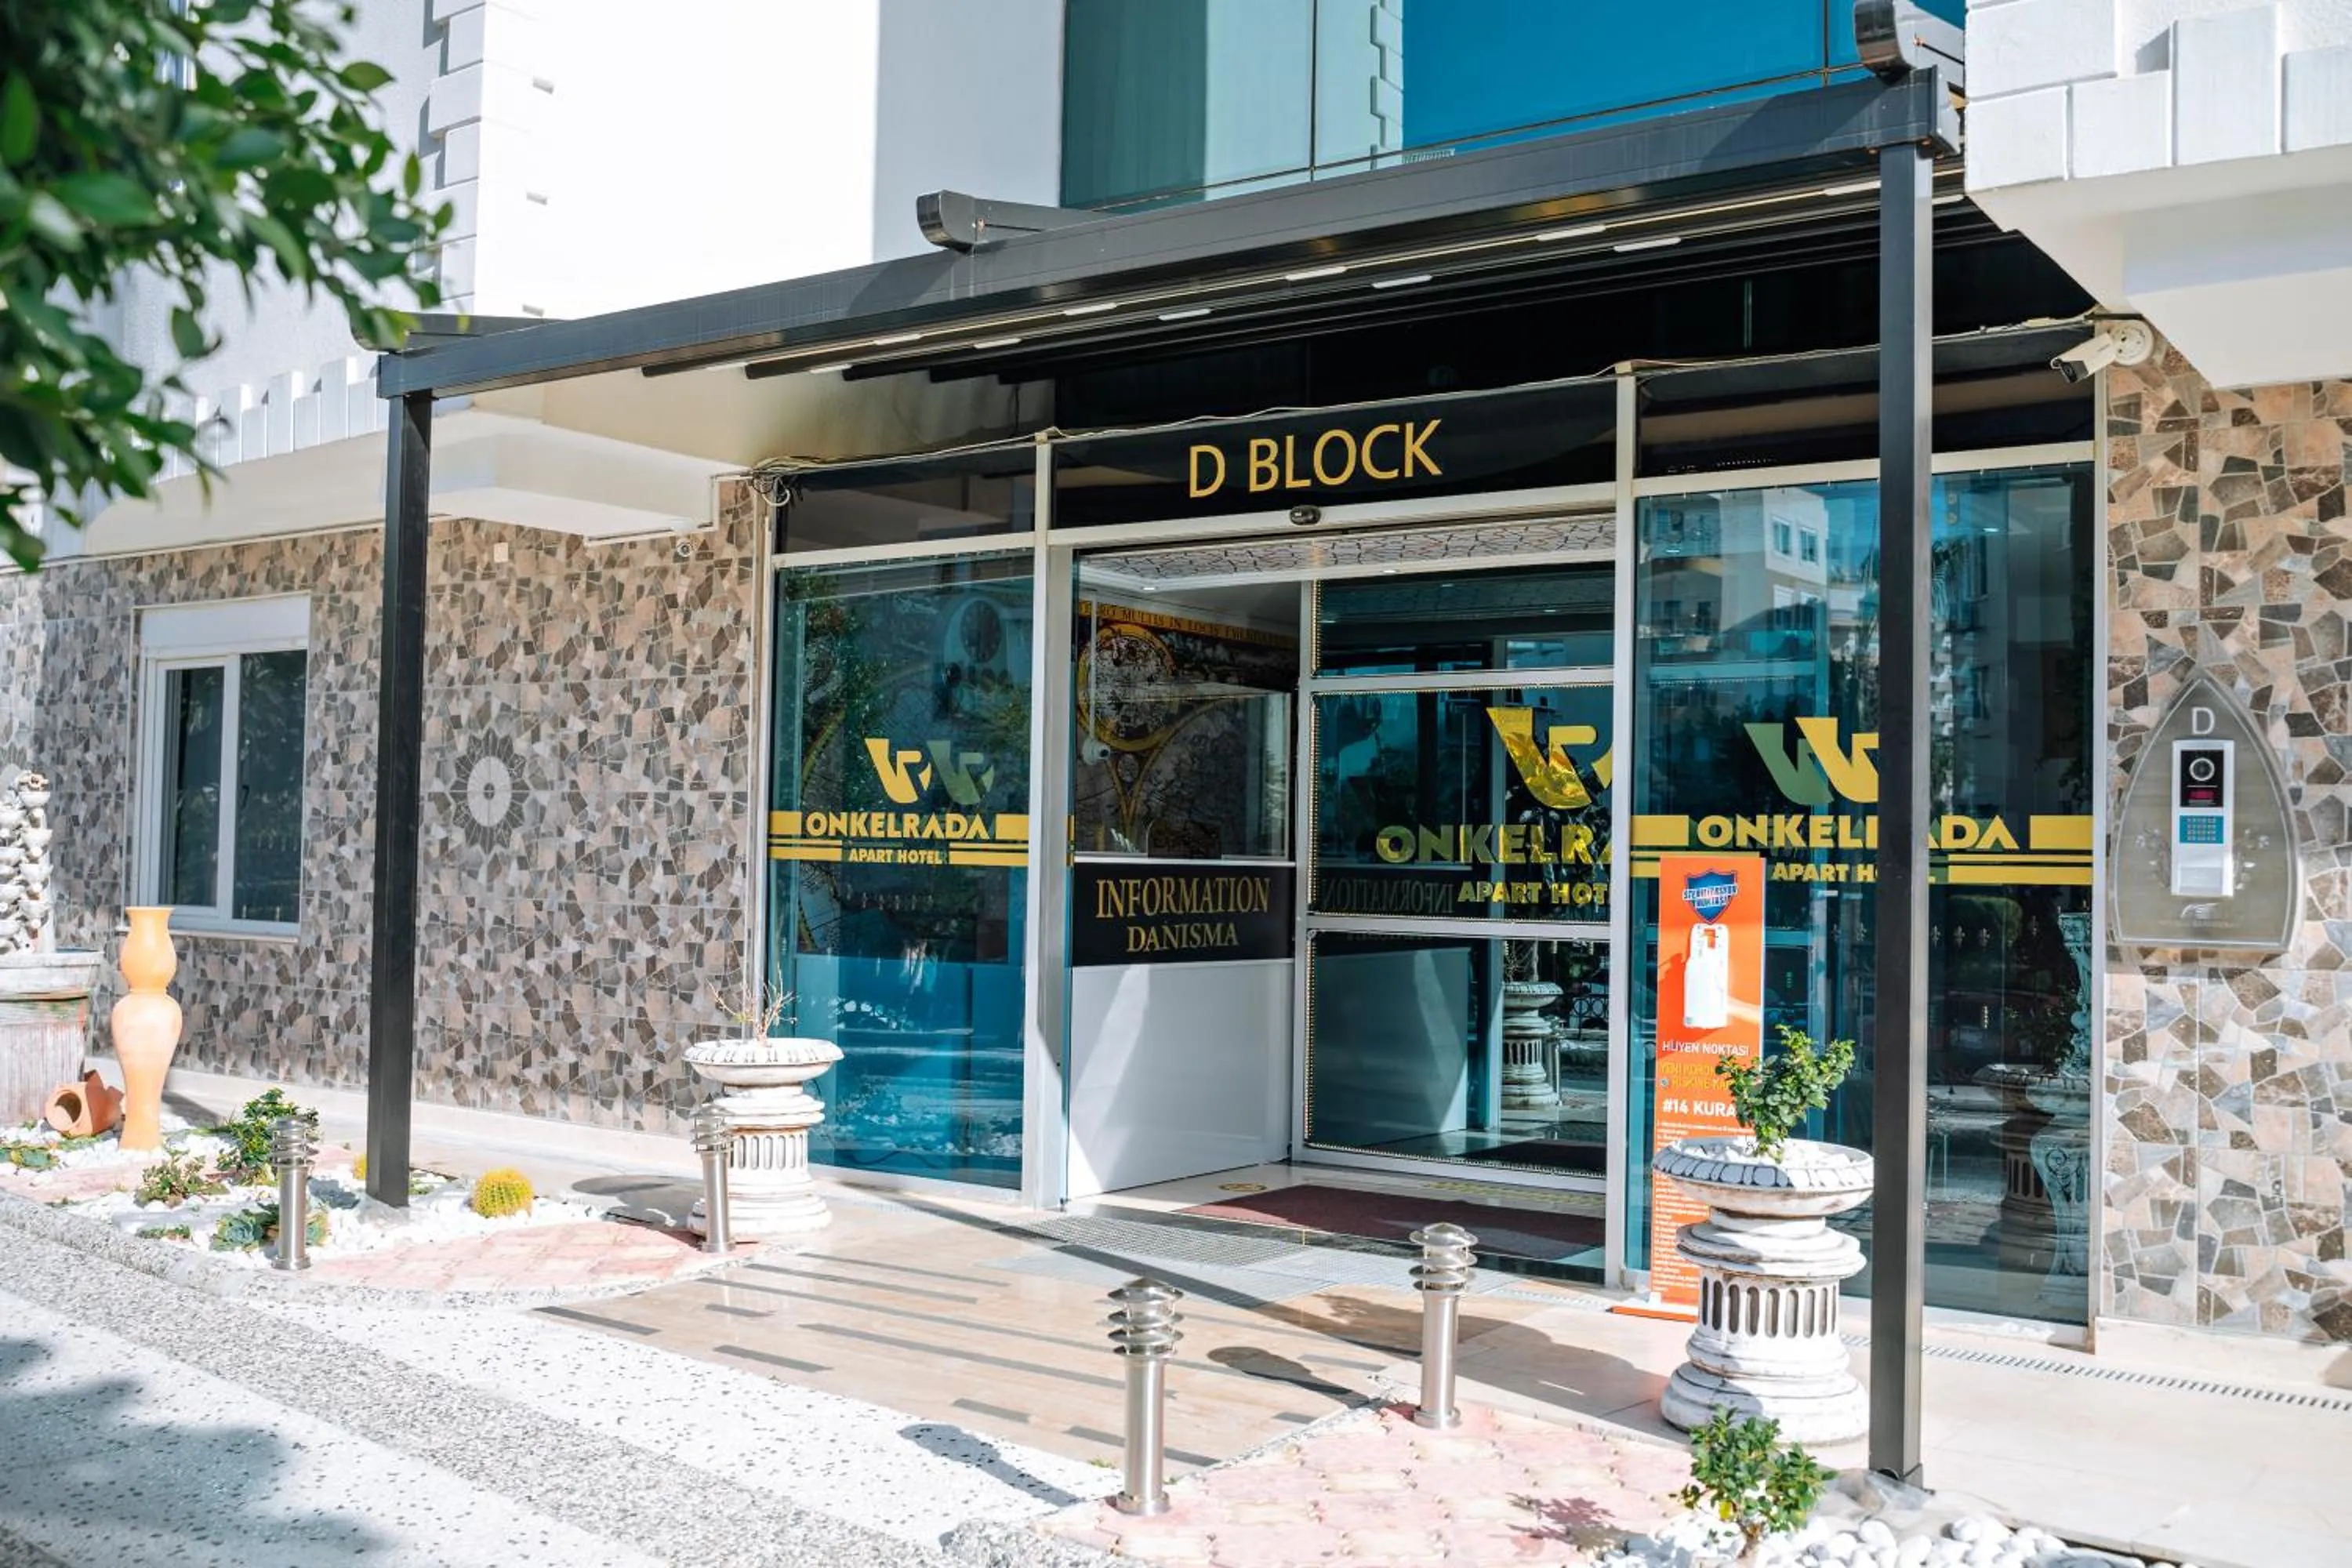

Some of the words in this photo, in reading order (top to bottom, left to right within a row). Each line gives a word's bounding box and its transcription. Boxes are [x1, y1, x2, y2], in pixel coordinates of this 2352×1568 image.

[1189, 445, 1225, 498] D
[1249, 419, 1443, 493] BLOCK
[2192, 707, 2215, 735] D
[805, 811, 990, 840] ONKELRADA
[1697, 815, 2020, 849] ONKELDA
[849, 848, 893, 863] APART
[898, 849, 942, 865] HOTEL
[1772, 862, 1849, 882] APART
[1095, 876, 1271, 918] INFORMATION
[1457, 881, 1542, 903] APART
[1703, 1042, 1750, 1057] NOKTASI
[1663, 1098, 1689, 1115] #14
[1693, 1100, 1737, 1117] KURA
